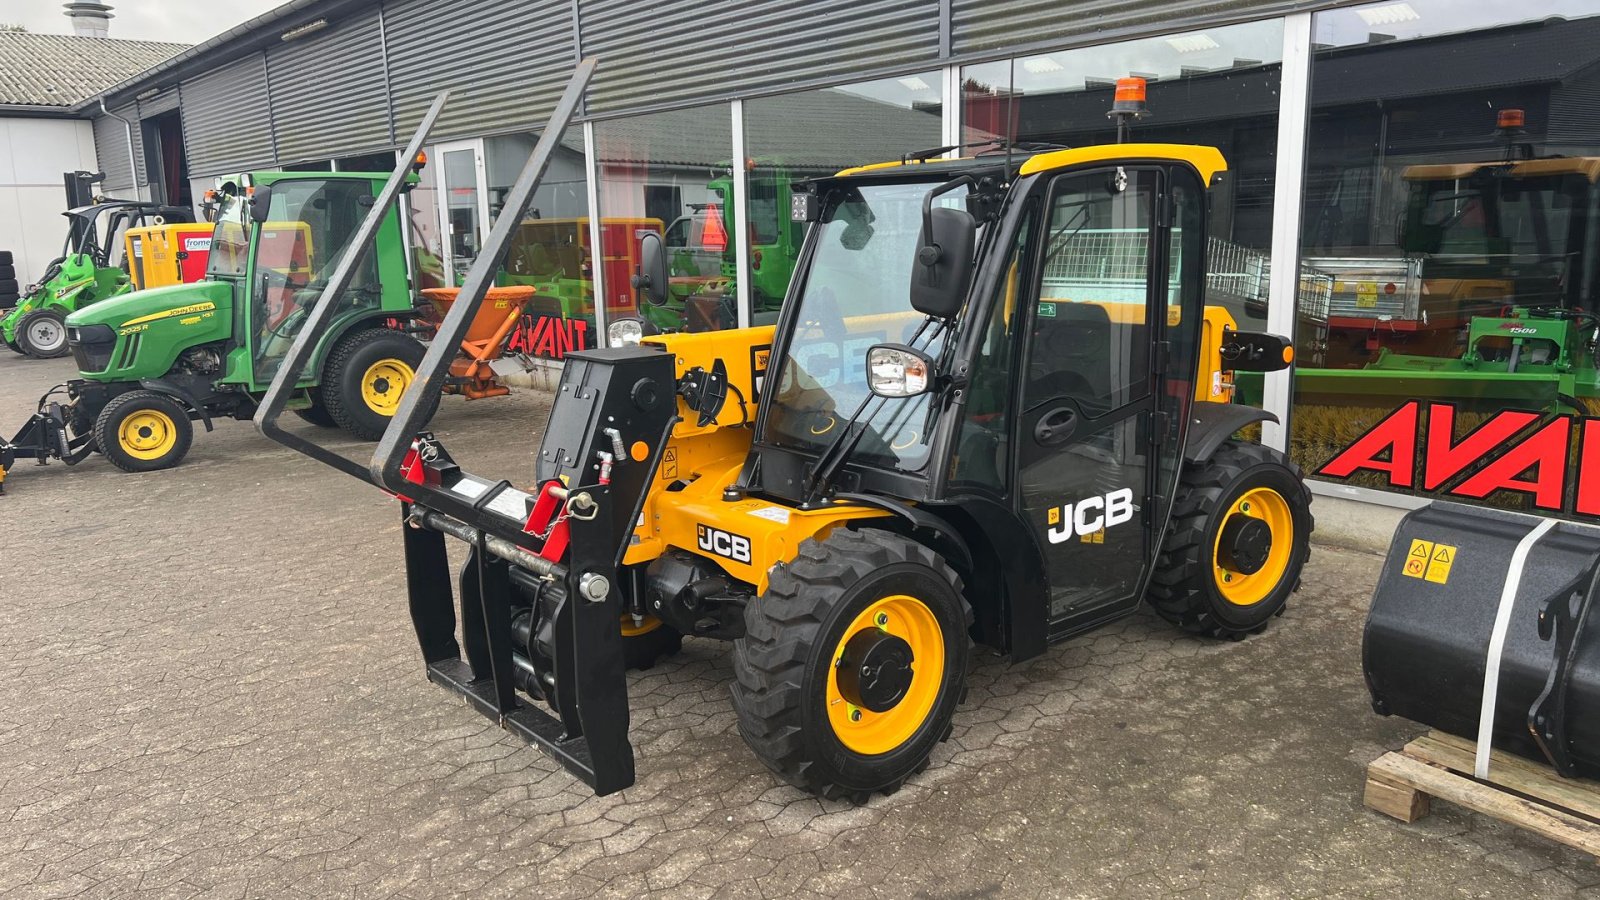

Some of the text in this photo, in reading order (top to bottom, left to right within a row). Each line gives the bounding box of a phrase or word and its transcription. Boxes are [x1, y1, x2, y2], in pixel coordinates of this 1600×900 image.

[120, 325, 142, 336] 2025
[169, 308, 188, 317] JOHN
[507, 314, 587, 359] AVANT
[1047, 487, 1133, 544] JCB
[698, 527, 751, 563] JCB
